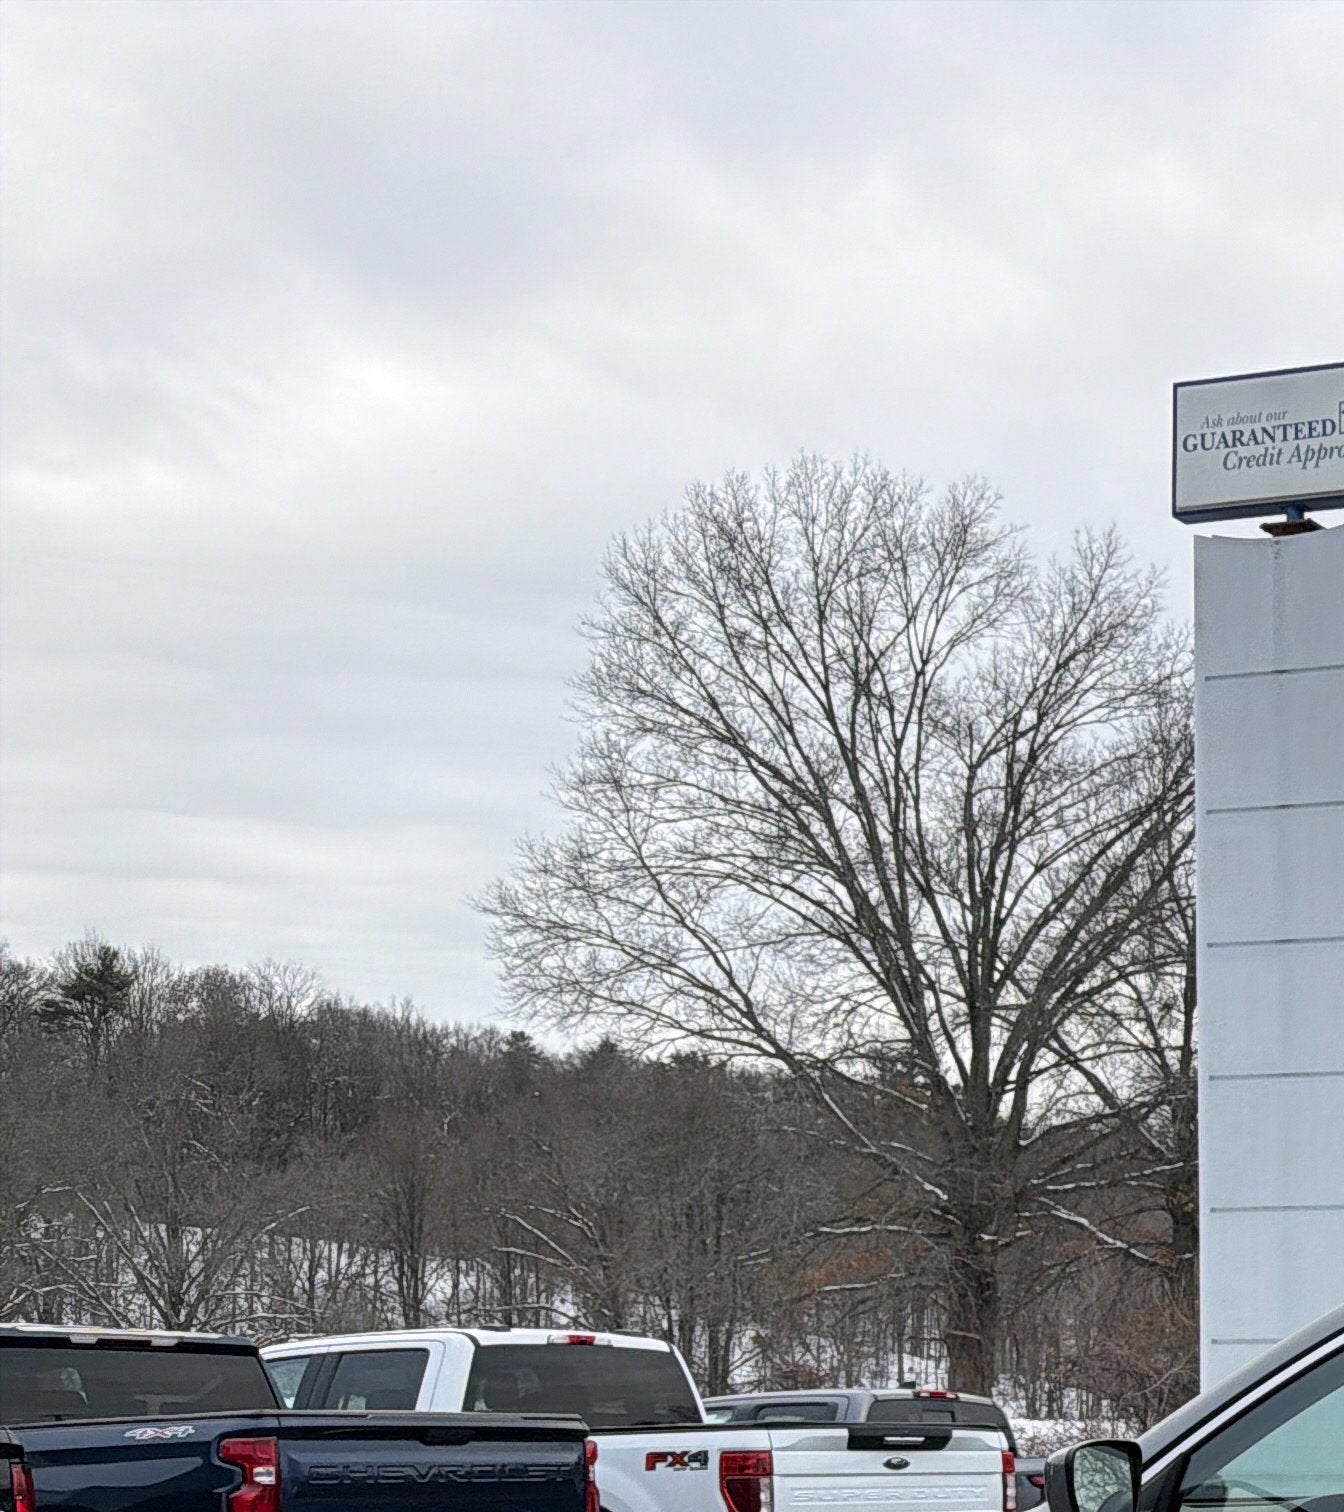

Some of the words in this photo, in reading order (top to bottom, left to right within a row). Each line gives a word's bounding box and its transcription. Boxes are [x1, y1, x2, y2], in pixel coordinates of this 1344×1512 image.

[1200, 414, 1224, 430] Ask
[1227, 412, 1262, 427] about
[1265, 409, 1289, 423] our
[1181, 418, 1337, 453] GUARANTEED
[1222, 446, 1283, 472] Credit
[644, 1449, 710, 1472] FX4
[308, 1463, 574, 1485] CHEVROLET
[793, 1487, 903, 1502] SUPER
[909, 1486, 988, 1501] DUTY
